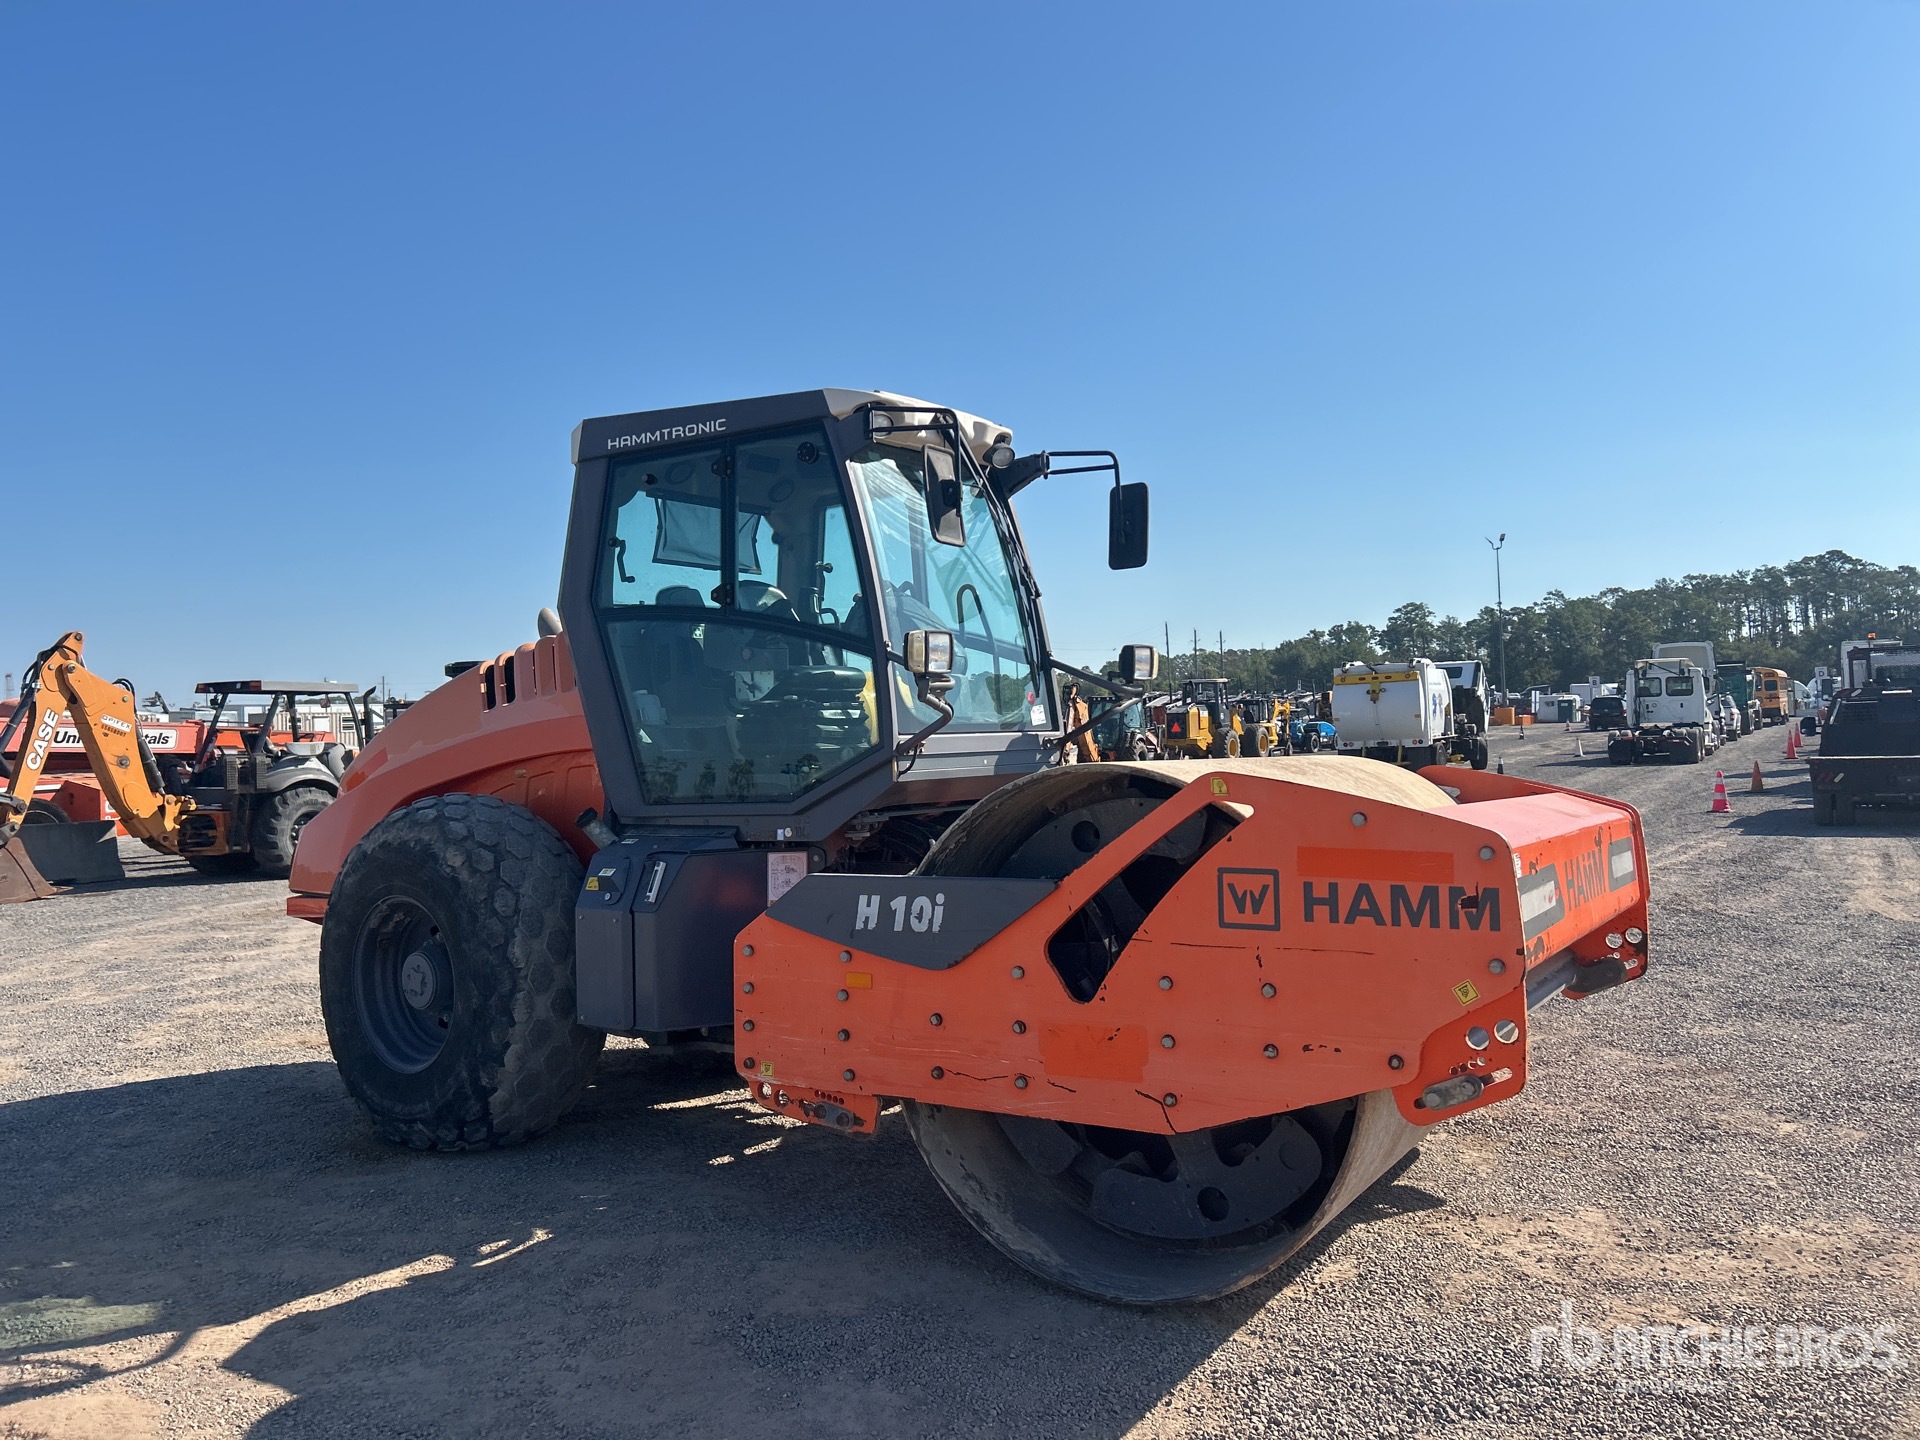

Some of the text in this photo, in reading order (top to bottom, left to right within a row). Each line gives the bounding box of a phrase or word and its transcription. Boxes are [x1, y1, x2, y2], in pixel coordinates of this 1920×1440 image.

[607, 418, 727, 449] HAMMTRONIC
[26, 707, 59, 770] CASE
[1564, 848, 1607, 912] HAMM
[855, 892, 945, 934] H 10i
[1303, 881, 1501, 932] HAMM
